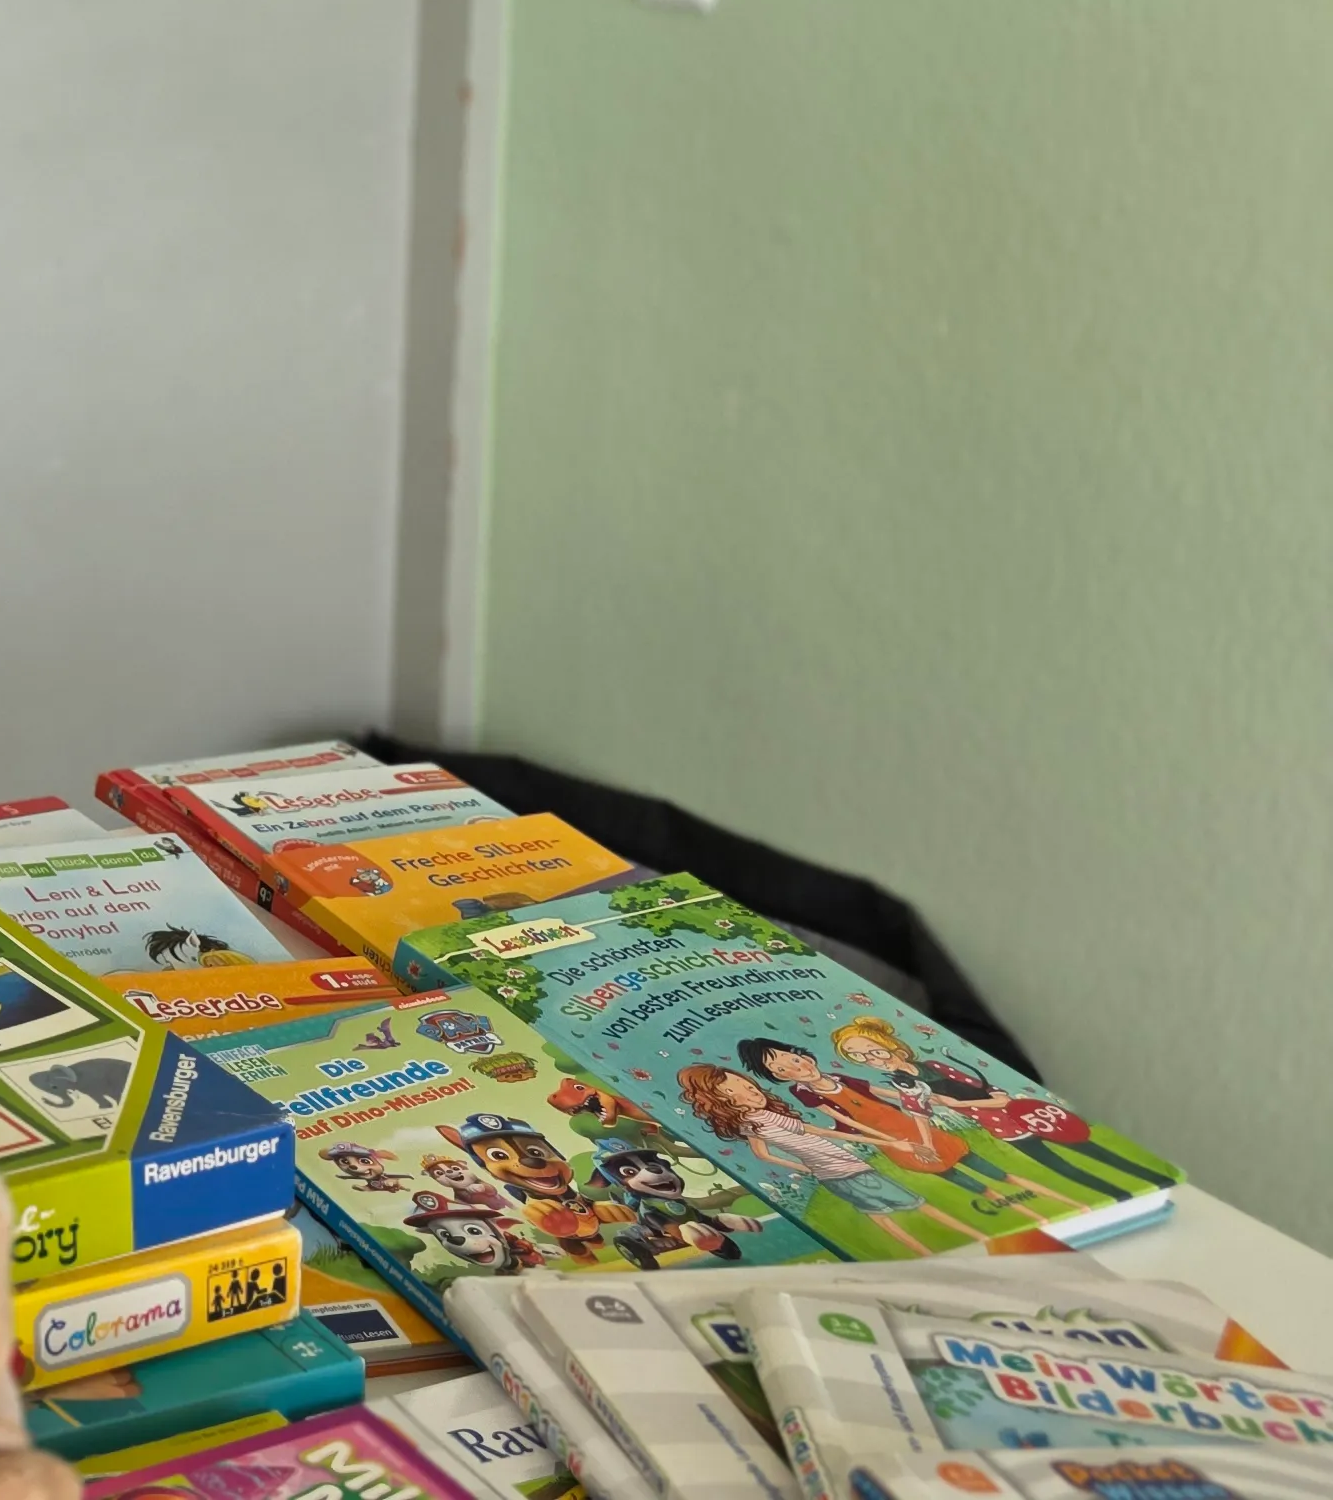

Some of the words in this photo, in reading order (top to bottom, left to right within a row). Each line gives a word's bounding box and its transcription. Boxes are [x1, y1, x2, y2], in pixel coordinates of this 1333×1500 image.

[251, 821, 283, 834] Ein
[285, 817, 338, 831] Zebra
[339, 811, 369, 825] auf
[371, 806, 407, 820] dem
[411, 797, 482, 818] Ponyhof
[266, 788, 380, 812] Leserabe
[139, 849, 159, 860] du
[390, 848, 474, 873] Freche
[473, 837, 561, 860] Silben-
[427, 856, 573, 888] Geschichten
[23, 886, 81, 903] Leni
[86, 885, 103, 898] &
[102, 878, 163, 896] Lotti
[64, 902, 100, 919] auf
[104, 899, 152, 916] dem
[480, 924, 581, 955] Leselöwen
[546, 965, 585, 987] Die
[581, 934, 686, 972] schönsten
[320, 972, 349, 989] 1.
[560, 947, 774, 1022] Silbengeschichten
[131, 991, 283, 1021] Leserabe
[602, 1015, 638, 1040] von
[629, 989, 686, 1023] besten
[684, 963, 828, 1000] Freundinnen
[663, 1018, 705, 1044] zum
[700, 986, 824, 1025] Lesenlernen
[209, 1046, 268, 1063] EINFACH
[453, 1034, 497, 1050] PATROL
[225, 1057, 268, 1074] LESEN
[238, 1066, 289, 1083] ERNEN
[318, 1058, 366, 1077] Die
[148, 1053, 199, 1143] Ravensburger
[296, 1121, 332, 1140] auf
[329, 1077, 476, 1129] Dino-Mission!
[144, 1137, 280, 1186] Ravensburger
[311, 1304, 353, 1315] mpfohlen
[44, 1296, 183, 1357] Colorama
[943, 1338, 1097, 1386] Mein
[995, 1372, 1333, 1445] Bilderbuch
